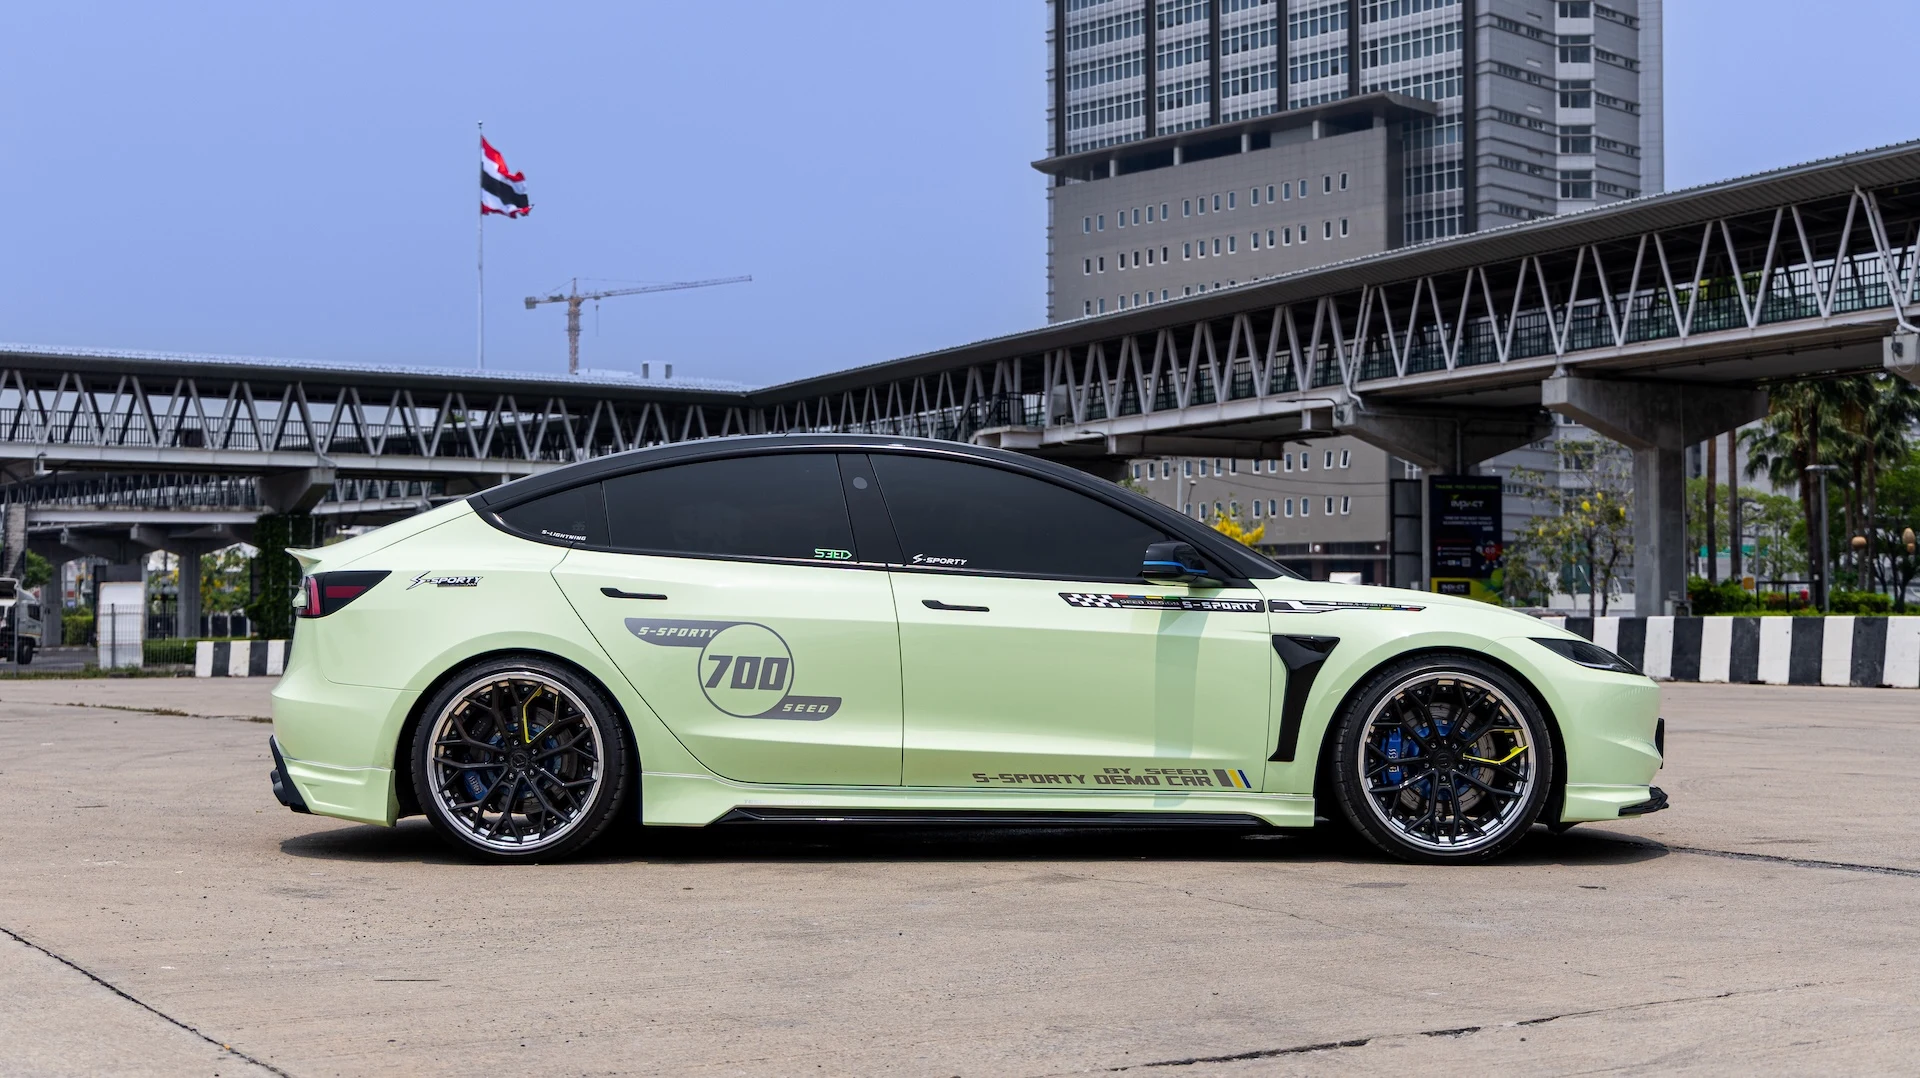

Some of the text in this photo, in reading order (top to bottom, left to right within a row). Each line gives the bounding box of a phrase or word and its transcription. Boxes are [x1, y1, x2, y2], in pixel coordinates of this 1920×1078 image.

[541, 529, 587, 541] S-LIGHTNING
[912, 553, 967, 566] S-SPORTY
[406, 570, 484, 591] S-SPORTY
[1181, 600, 1257, 611] S-SPORTY
[638, 626, 718, 639] S-SPORTY
[704, 654, 790, 691] 700
[782, 703, 829, 714] SEED
[1102, 767, 1208, 776] BY SEED
[972, 773, 1214, 787] S-SPORTY DEMO CAR
